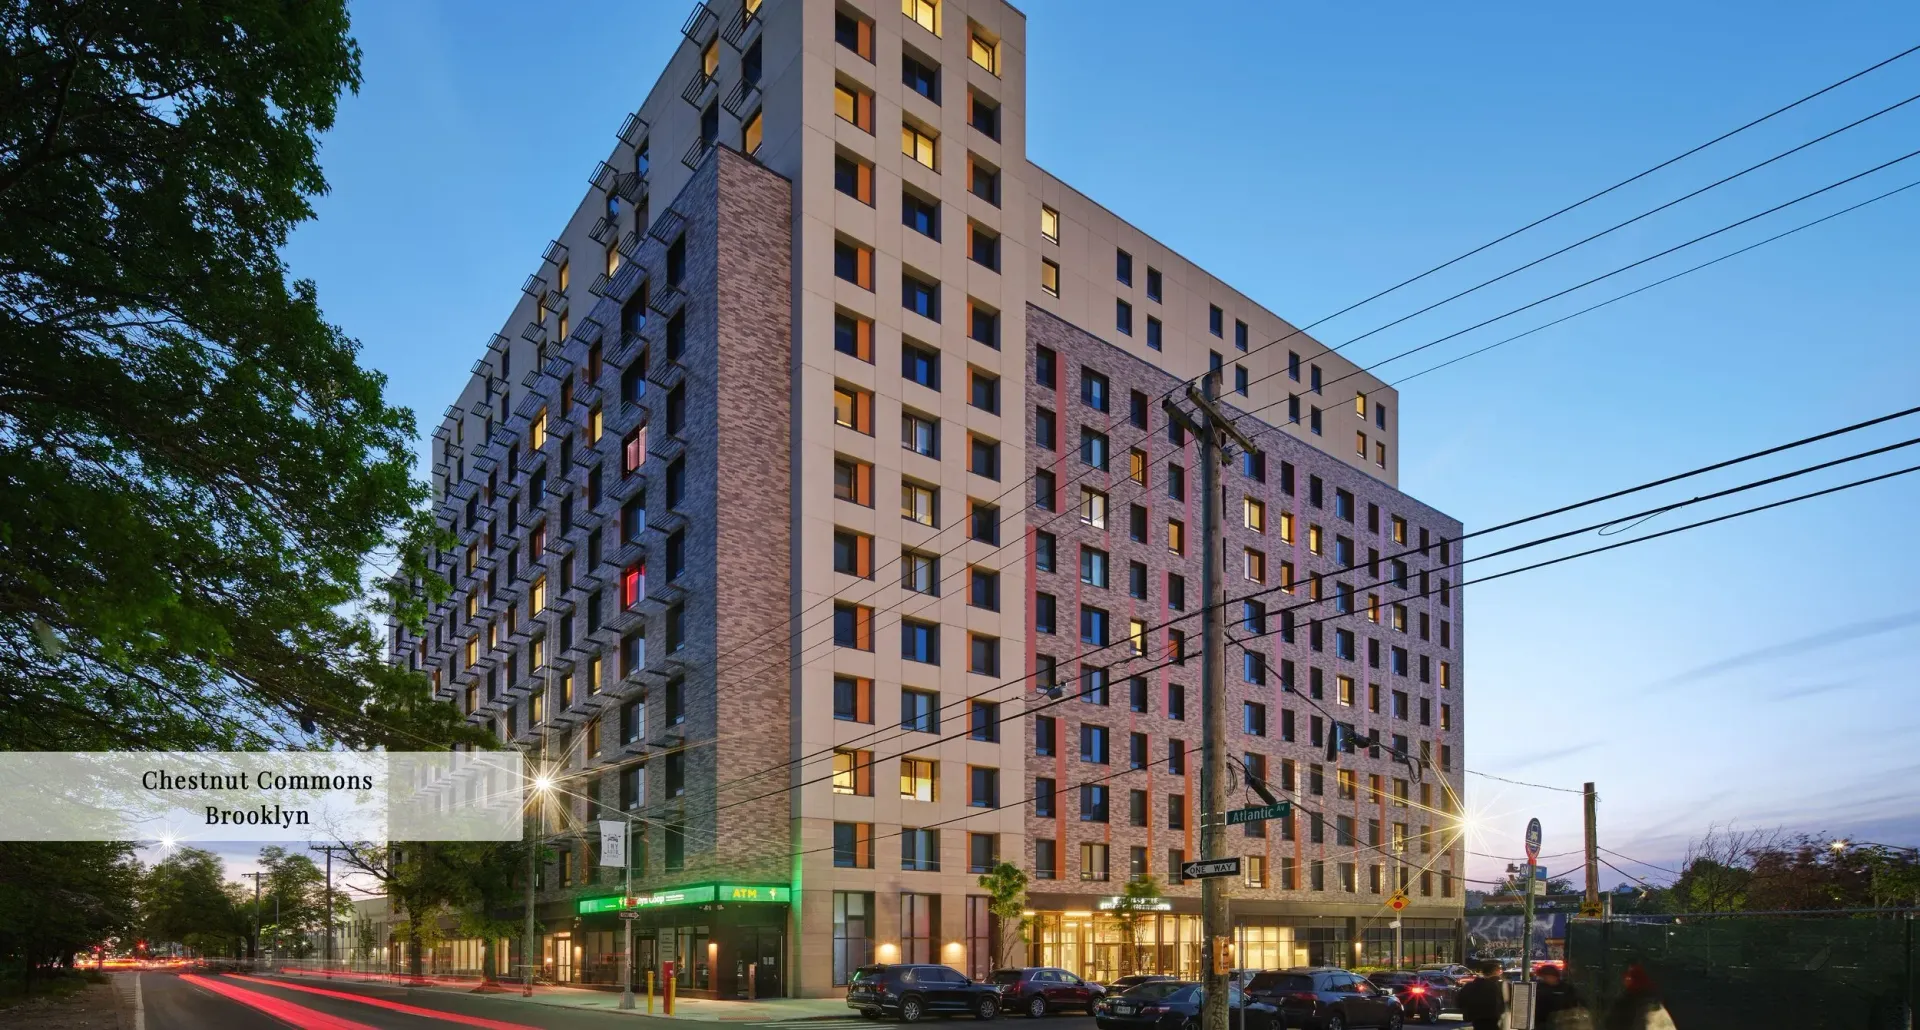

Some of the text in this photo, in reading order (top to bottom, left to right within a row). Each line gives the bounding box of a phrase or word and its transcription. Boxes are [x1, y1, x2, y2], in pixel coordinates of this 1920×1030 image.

[1232, 806, 1275, 823] Atlantic
[1189, 863, 1232, 875] ONE WAY
[732, 887, 757, 899] ATM
